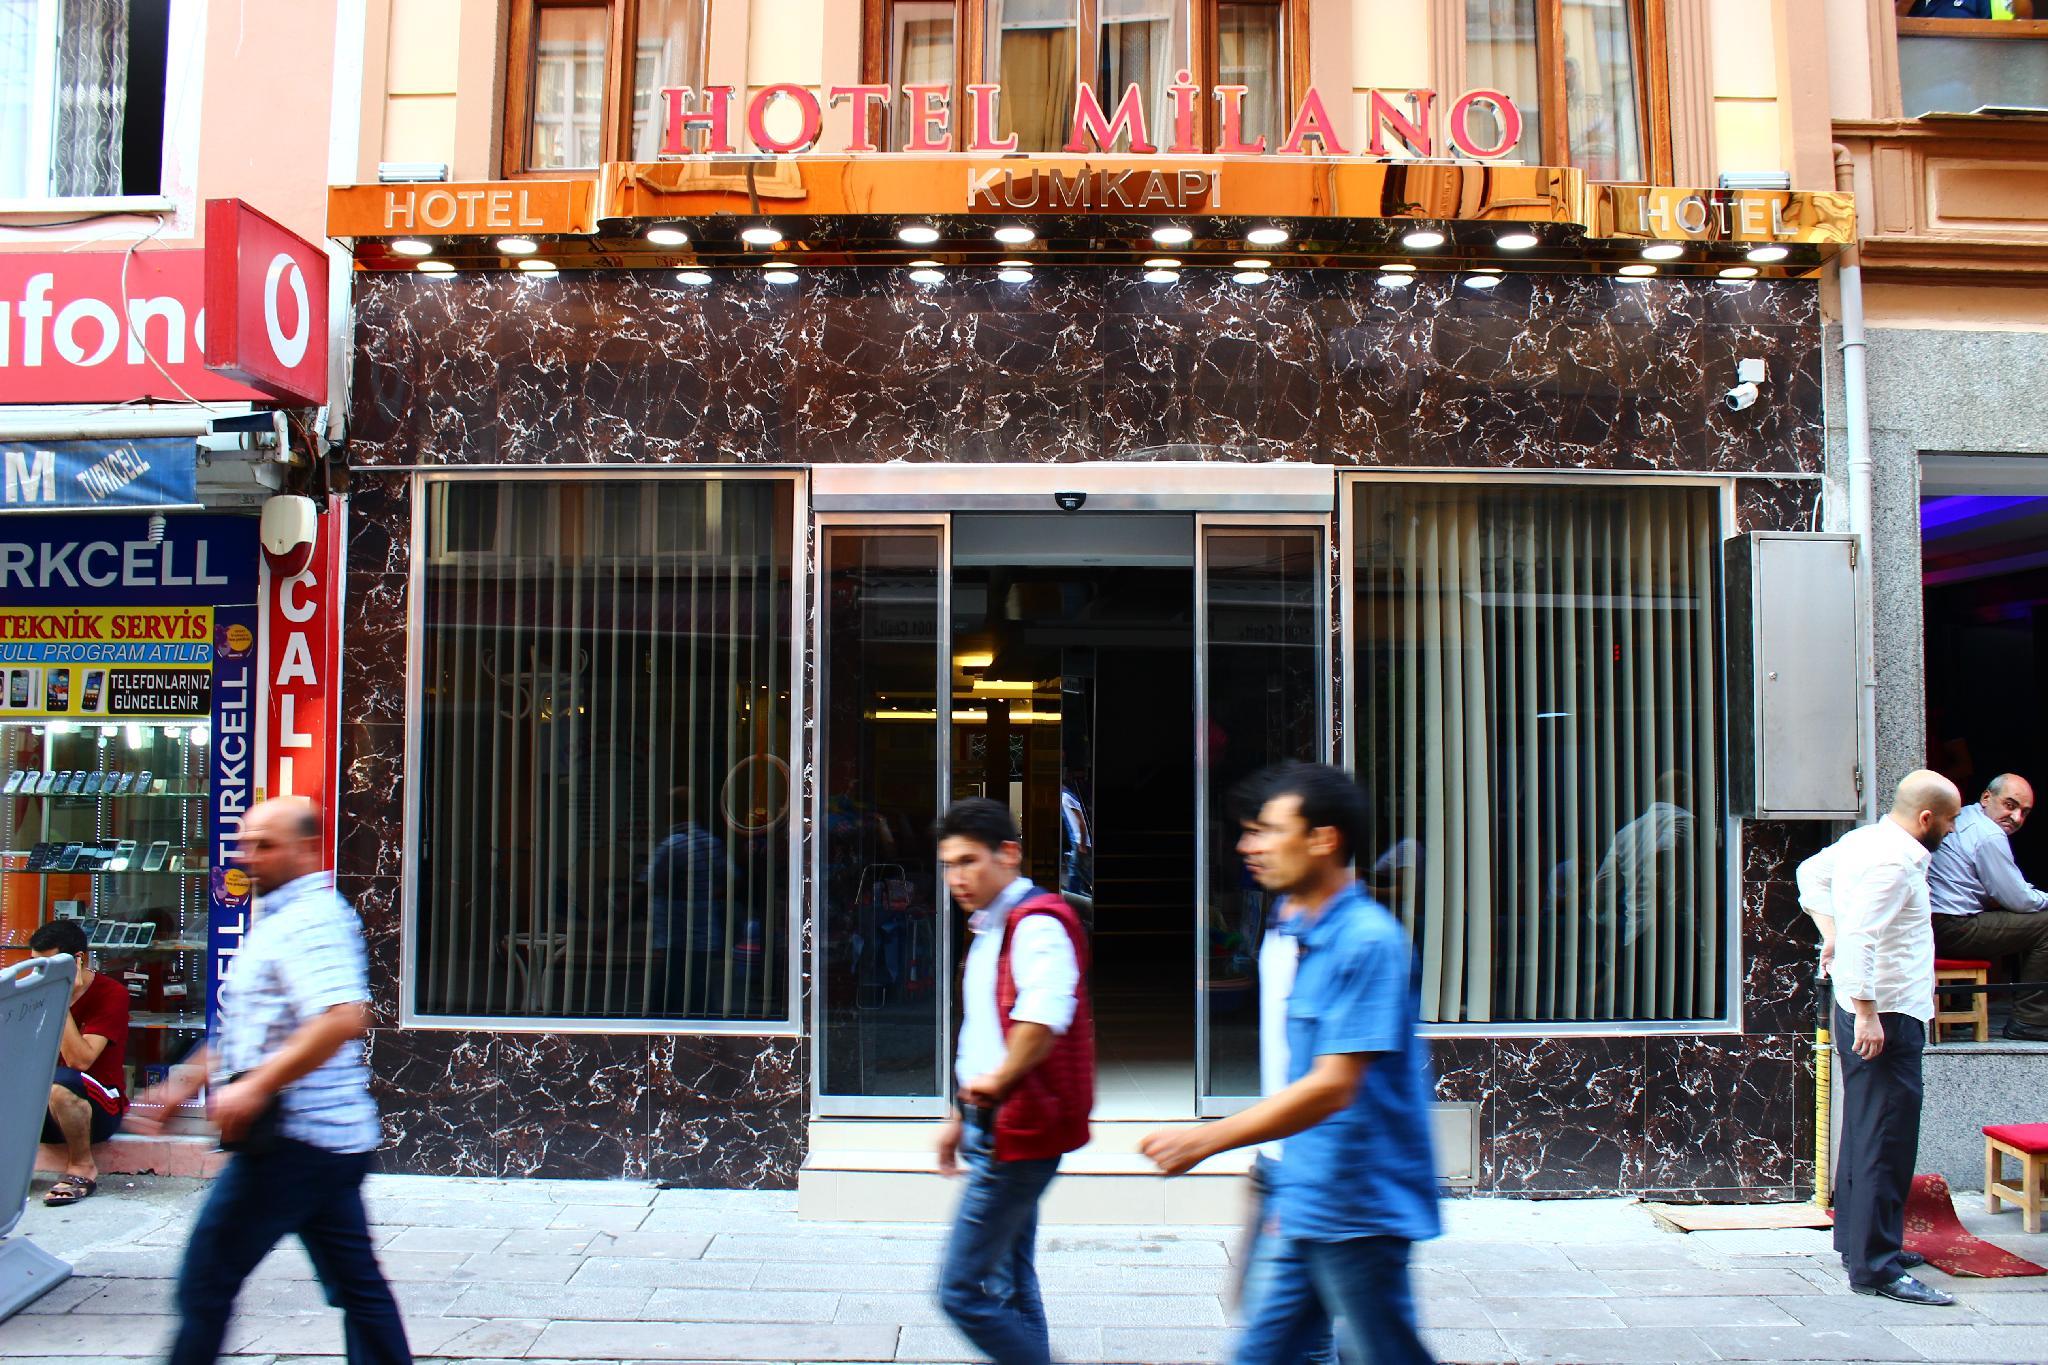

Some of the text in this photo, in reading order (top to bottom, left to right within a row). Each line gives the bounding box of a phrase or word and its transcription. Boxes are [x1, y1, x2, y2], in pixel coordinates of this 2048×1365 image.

[660, 68, 1523, 158] HOTEL MİLANO
[967, 167, 1221, 208] KUMKAPI
[384, 189, 544, 228] HOTEL
[1638, 195, 1798, 235] HOTEL
[0, 272, 206, 368] fon
[75, 441, 151, 503] TURKCELL
[0, 608, 207, 640] TEKNİK SERVİS
[43, 644, 146, 661] PROGRAM
[148, 644, 209, 661] ATILIR
[111, 674, 210, 690] TELEFONLARINIZ
[114, 690, 199, 710] GÜNCELLENİR
[219, 666, 248, 866] TURKCELL
